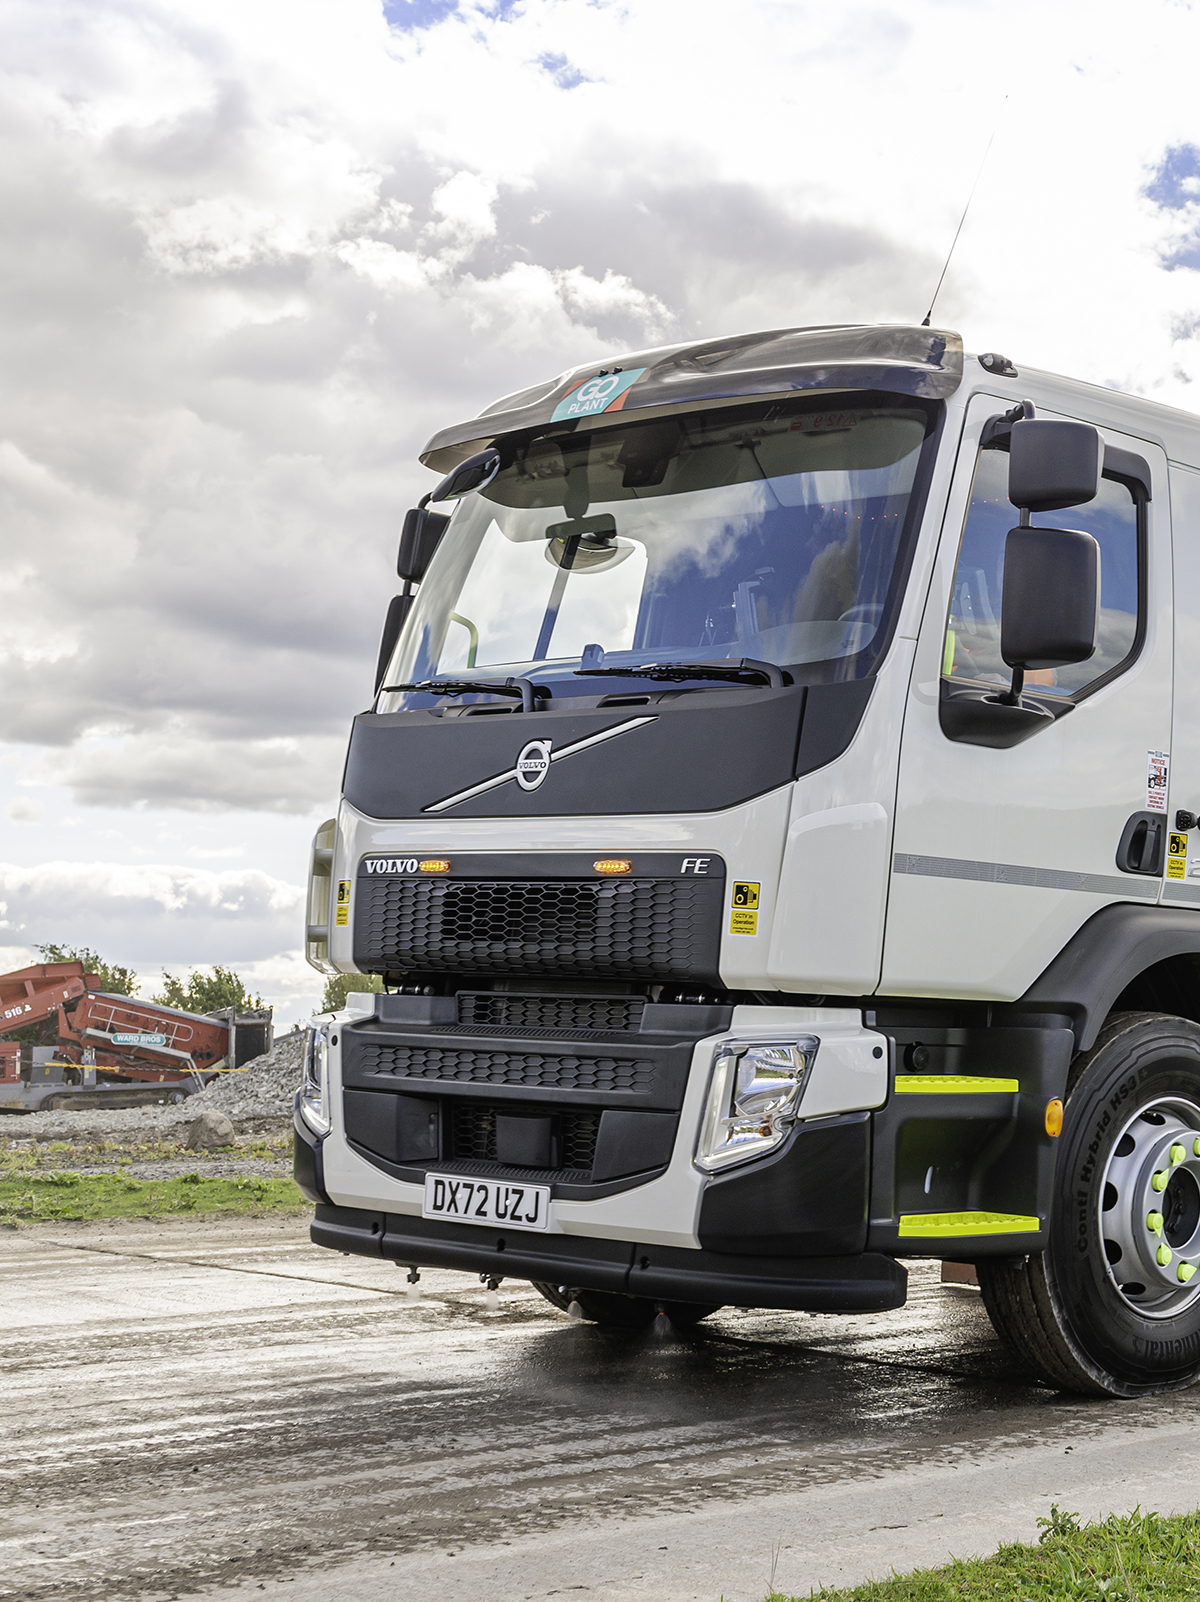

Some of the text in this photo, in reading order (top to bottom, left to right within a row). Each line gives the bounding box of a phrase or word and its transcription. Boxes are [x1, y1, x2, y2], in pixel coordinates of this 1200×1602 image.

[576, 375, 620, 402] GO
[567, 397, 609, 415] PLANT
[519, 761, 547, 769] VOLVO
[364, 858, 419, 874] VOLVO
[680, 858, 711, 874] FE
[117, 1034, 161, 1043] WARD BROS
[1080, 1109, 1112, 1183] Hybrid
[432, 1179, 540, 1223] DX72 UZJ
